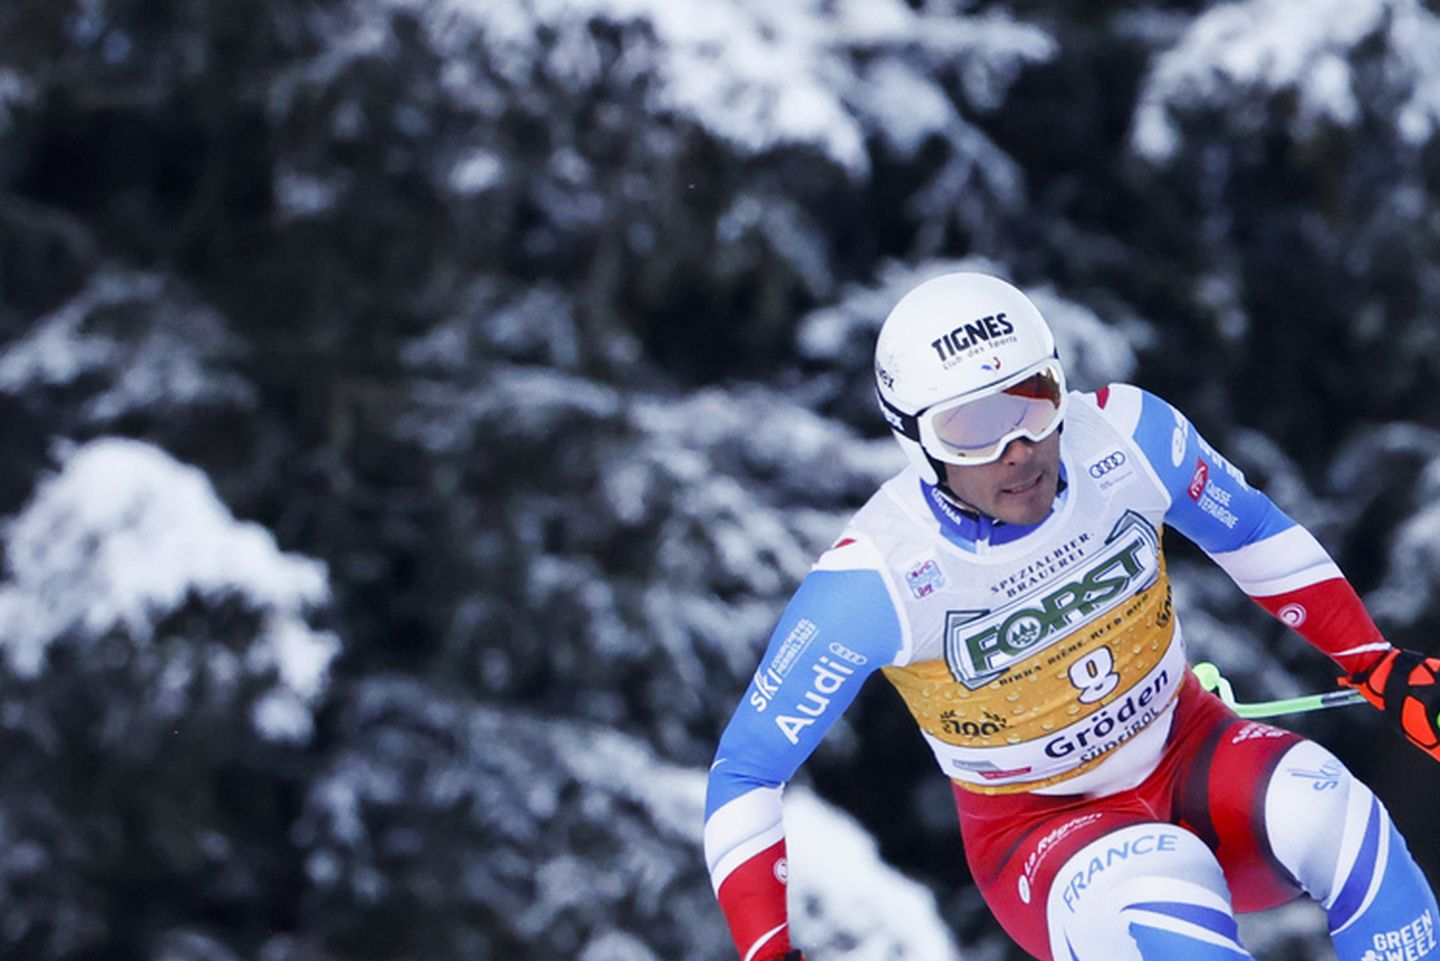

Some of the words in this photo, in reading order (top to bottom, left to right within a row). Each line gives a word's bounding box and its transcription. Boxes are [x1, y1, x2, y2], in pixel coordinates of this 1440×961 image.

[931, 312, 1014, 361] TIGNES
[965, 536, 1146, 672] FORST
[1005, 549, 1085, 598] BRAUEREI
[774, 656, 854, 745] Audi
[1067, 644, 1120, 704] 8
[1044, 669, 1169, 759] Gröden
[1062, 834, 1179, 914] FRANCE
[1373, 908, 1433, 951] GREEN
